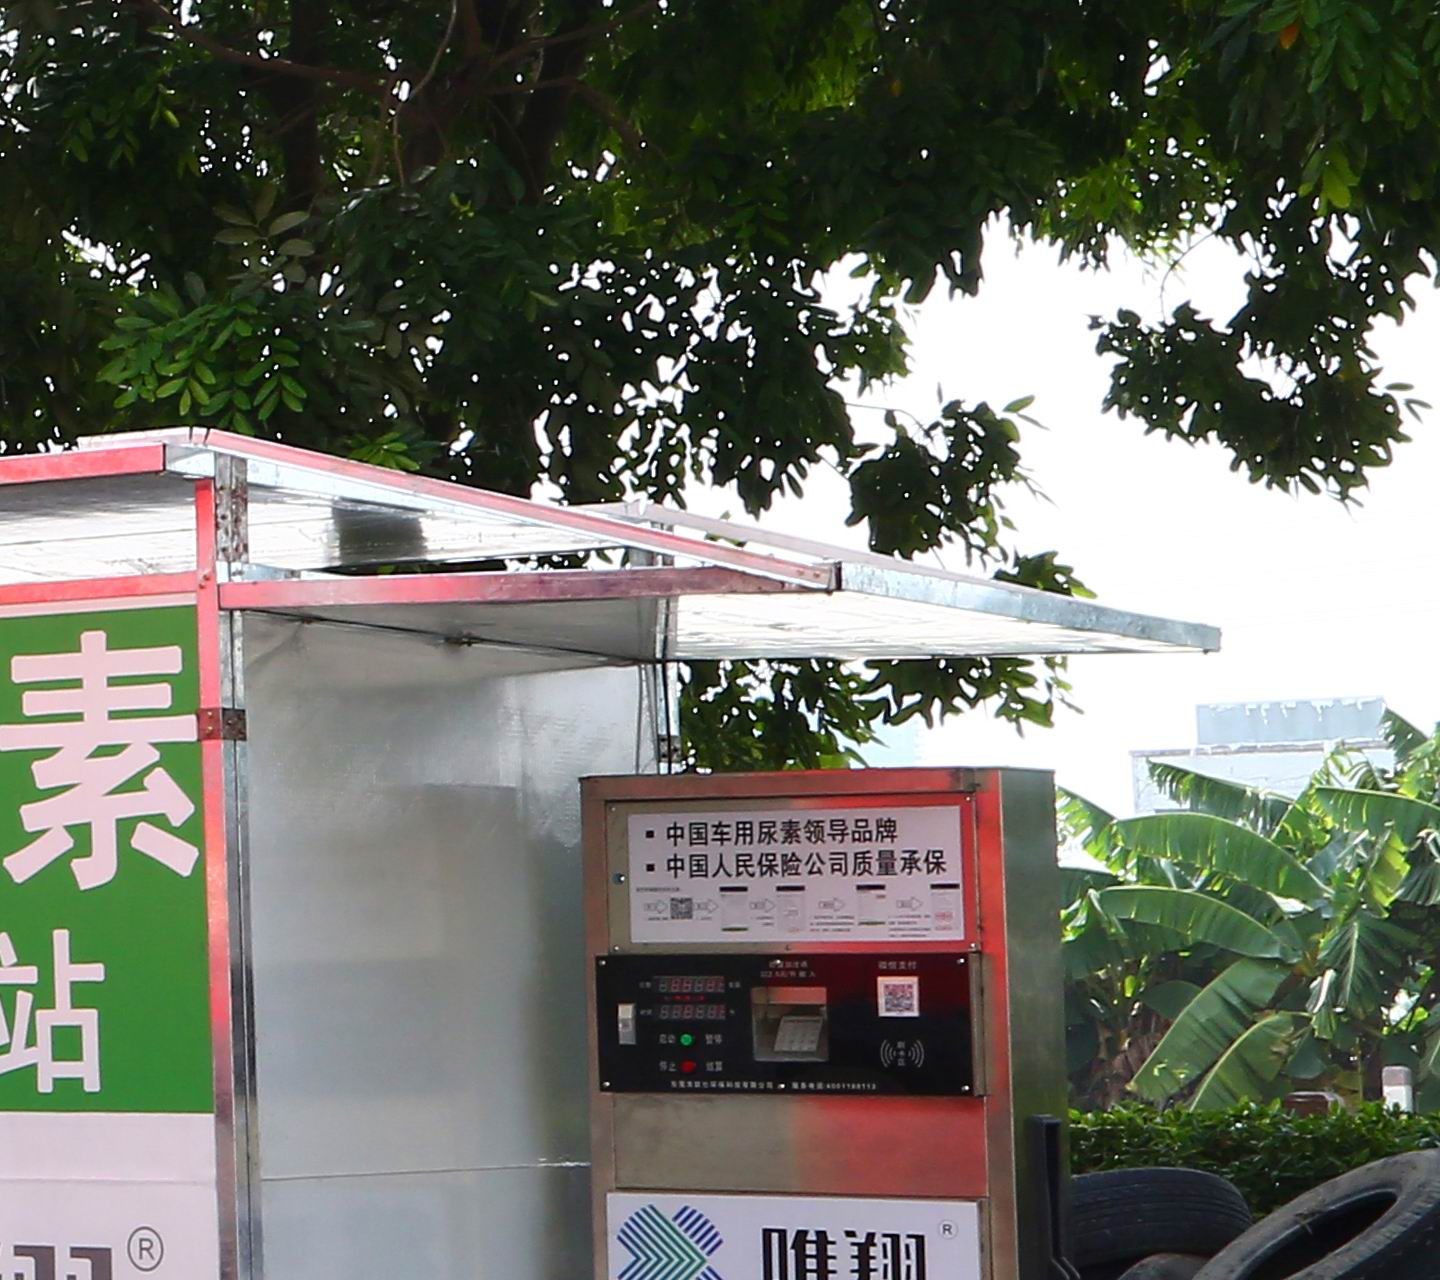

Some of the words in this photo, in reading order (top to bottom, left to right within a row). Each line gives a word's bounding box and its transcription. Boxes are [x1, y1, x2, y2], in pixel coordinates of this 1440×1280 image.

[665, 816, 899, 847] 中国车用尿素领导品牌
[665, 849, 947, 879] 中国人民保险公司质量承保
